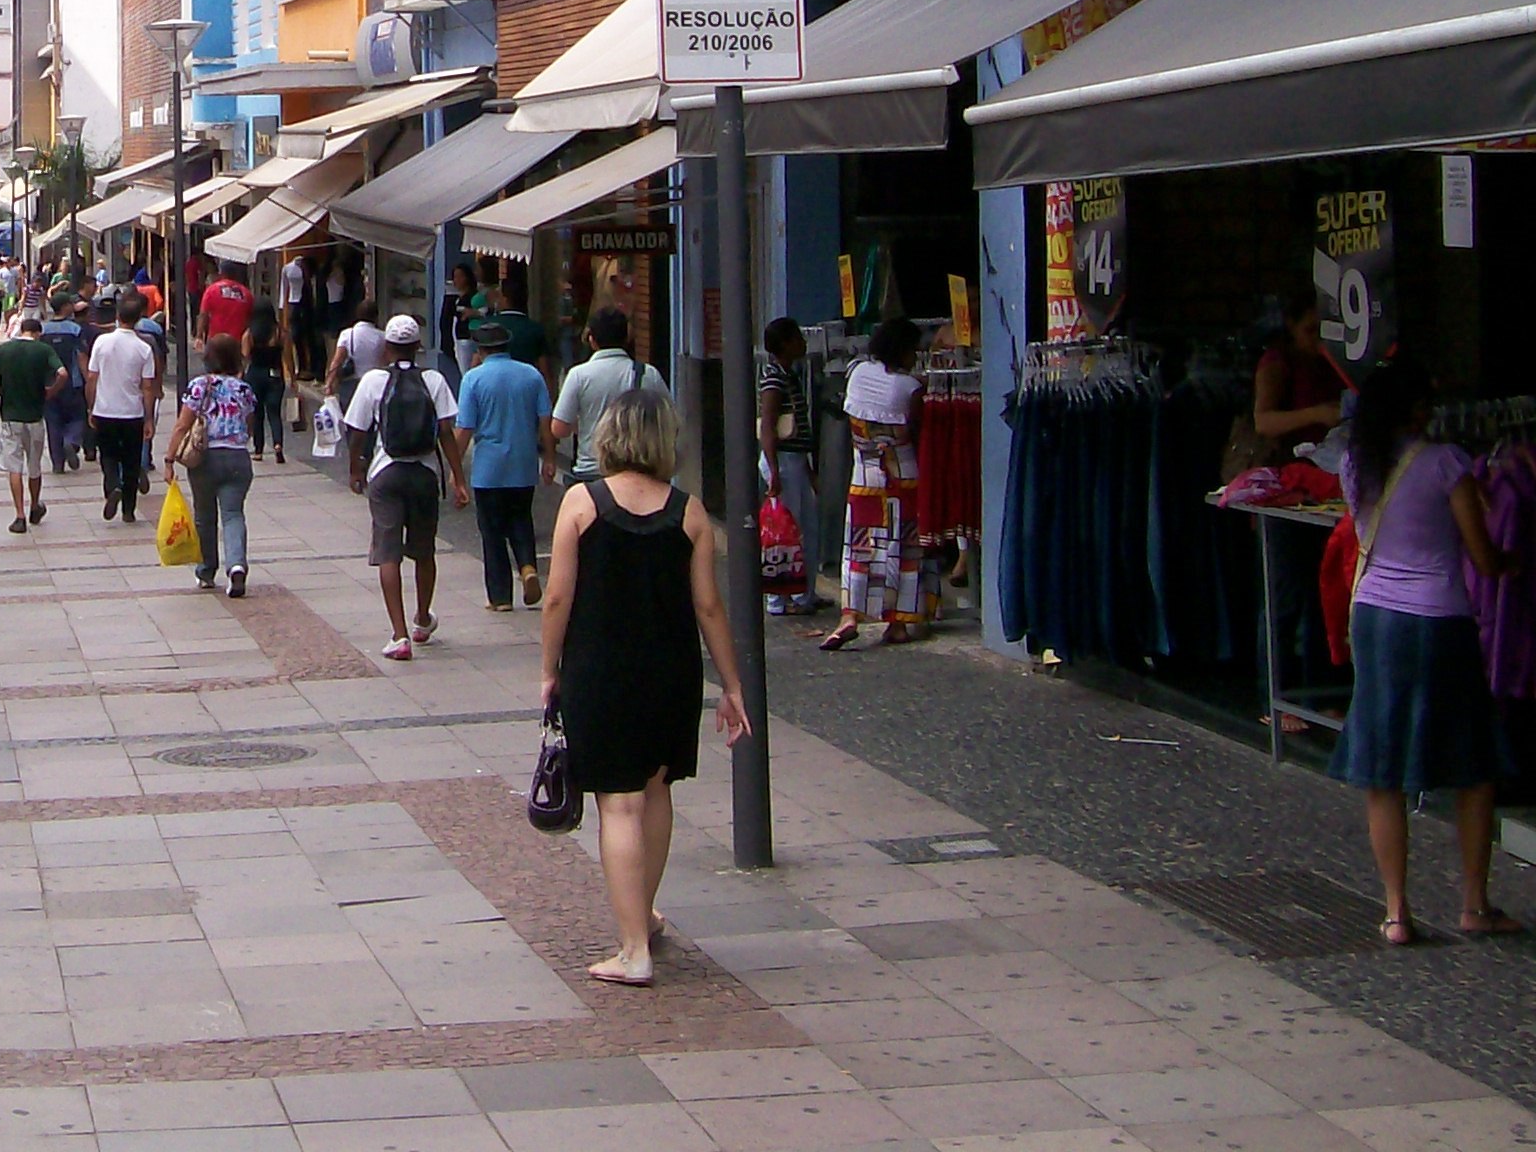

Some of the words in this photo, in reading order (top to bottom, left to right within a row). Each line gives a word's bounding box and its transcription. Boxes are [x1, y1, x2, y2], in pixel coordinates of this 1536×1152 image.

[666, 7, 795, 31] RESOLUÇÃO
[688, 34, 773, 51] 210/2006
[1080, 199, 1119, 223] OFERTA
[1315, 190, 1387, 233] SUPER
[1327, 225, 1381, 257] OFERTA
